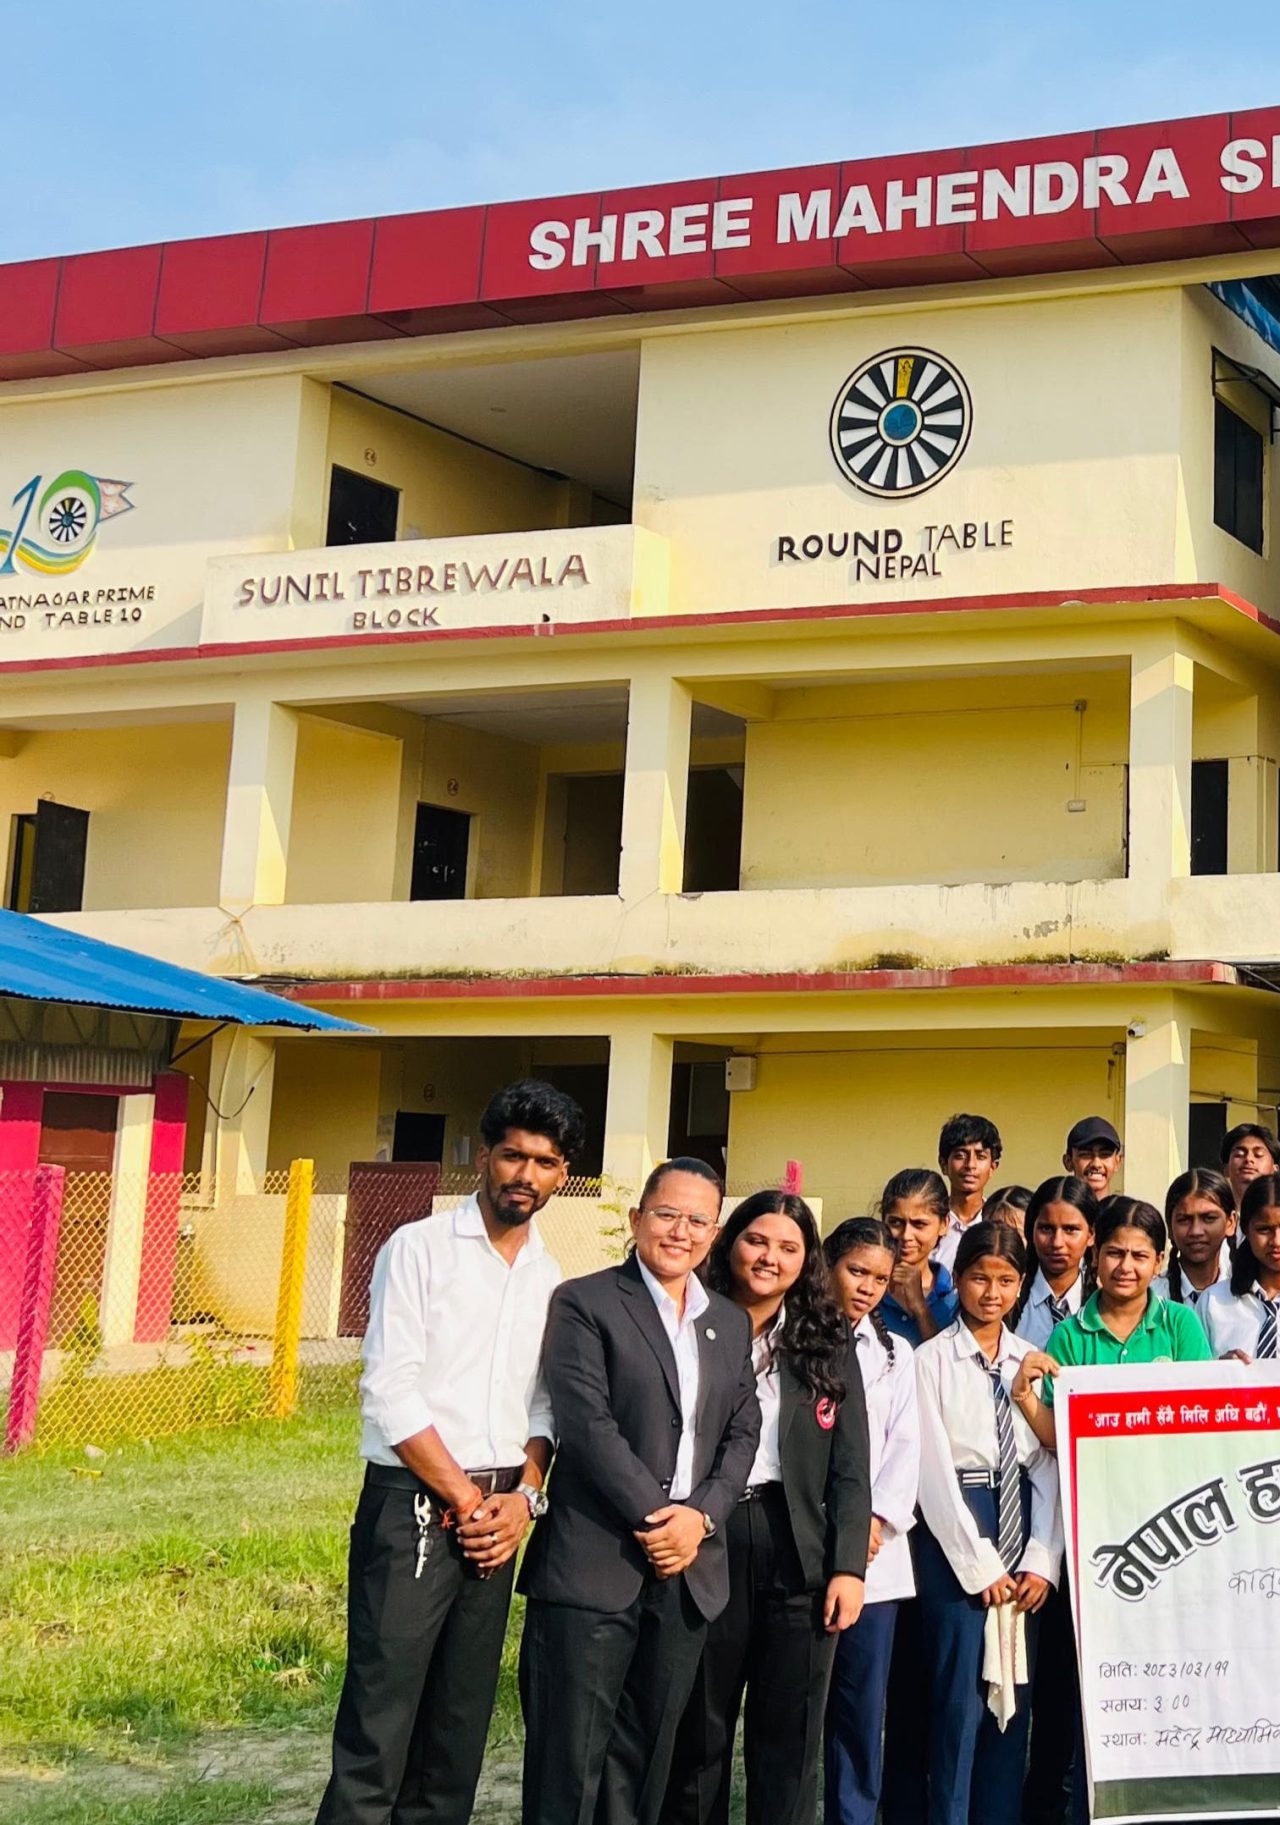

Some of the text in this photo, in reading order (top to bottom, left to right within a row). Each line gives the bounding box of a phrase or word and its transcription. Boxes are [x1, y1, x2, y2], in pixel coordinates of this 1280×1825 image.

[528, 198, 753, 270] SHREE
[777, 148, 1190, 244] MAHENDRA
[778, 520, 1013, 561] ROUND TABLE
[239, 554, 591, 607] SUNIL TIBREWALA
[856, 552, 942, 581] NEPAL
[0, 586, 156, 609] ATNAGAR PRIME
[45, 609, 112, 627] TABLE
[121, 607, 142, 622] 10
[353, 606, 441, 630] BLOCK
[1125, 1407, 1150, 1429] हामी
[1180, 1403, 1209, 1424] मिलि
[1093, 1476, 1236, 1597] नेपाल
